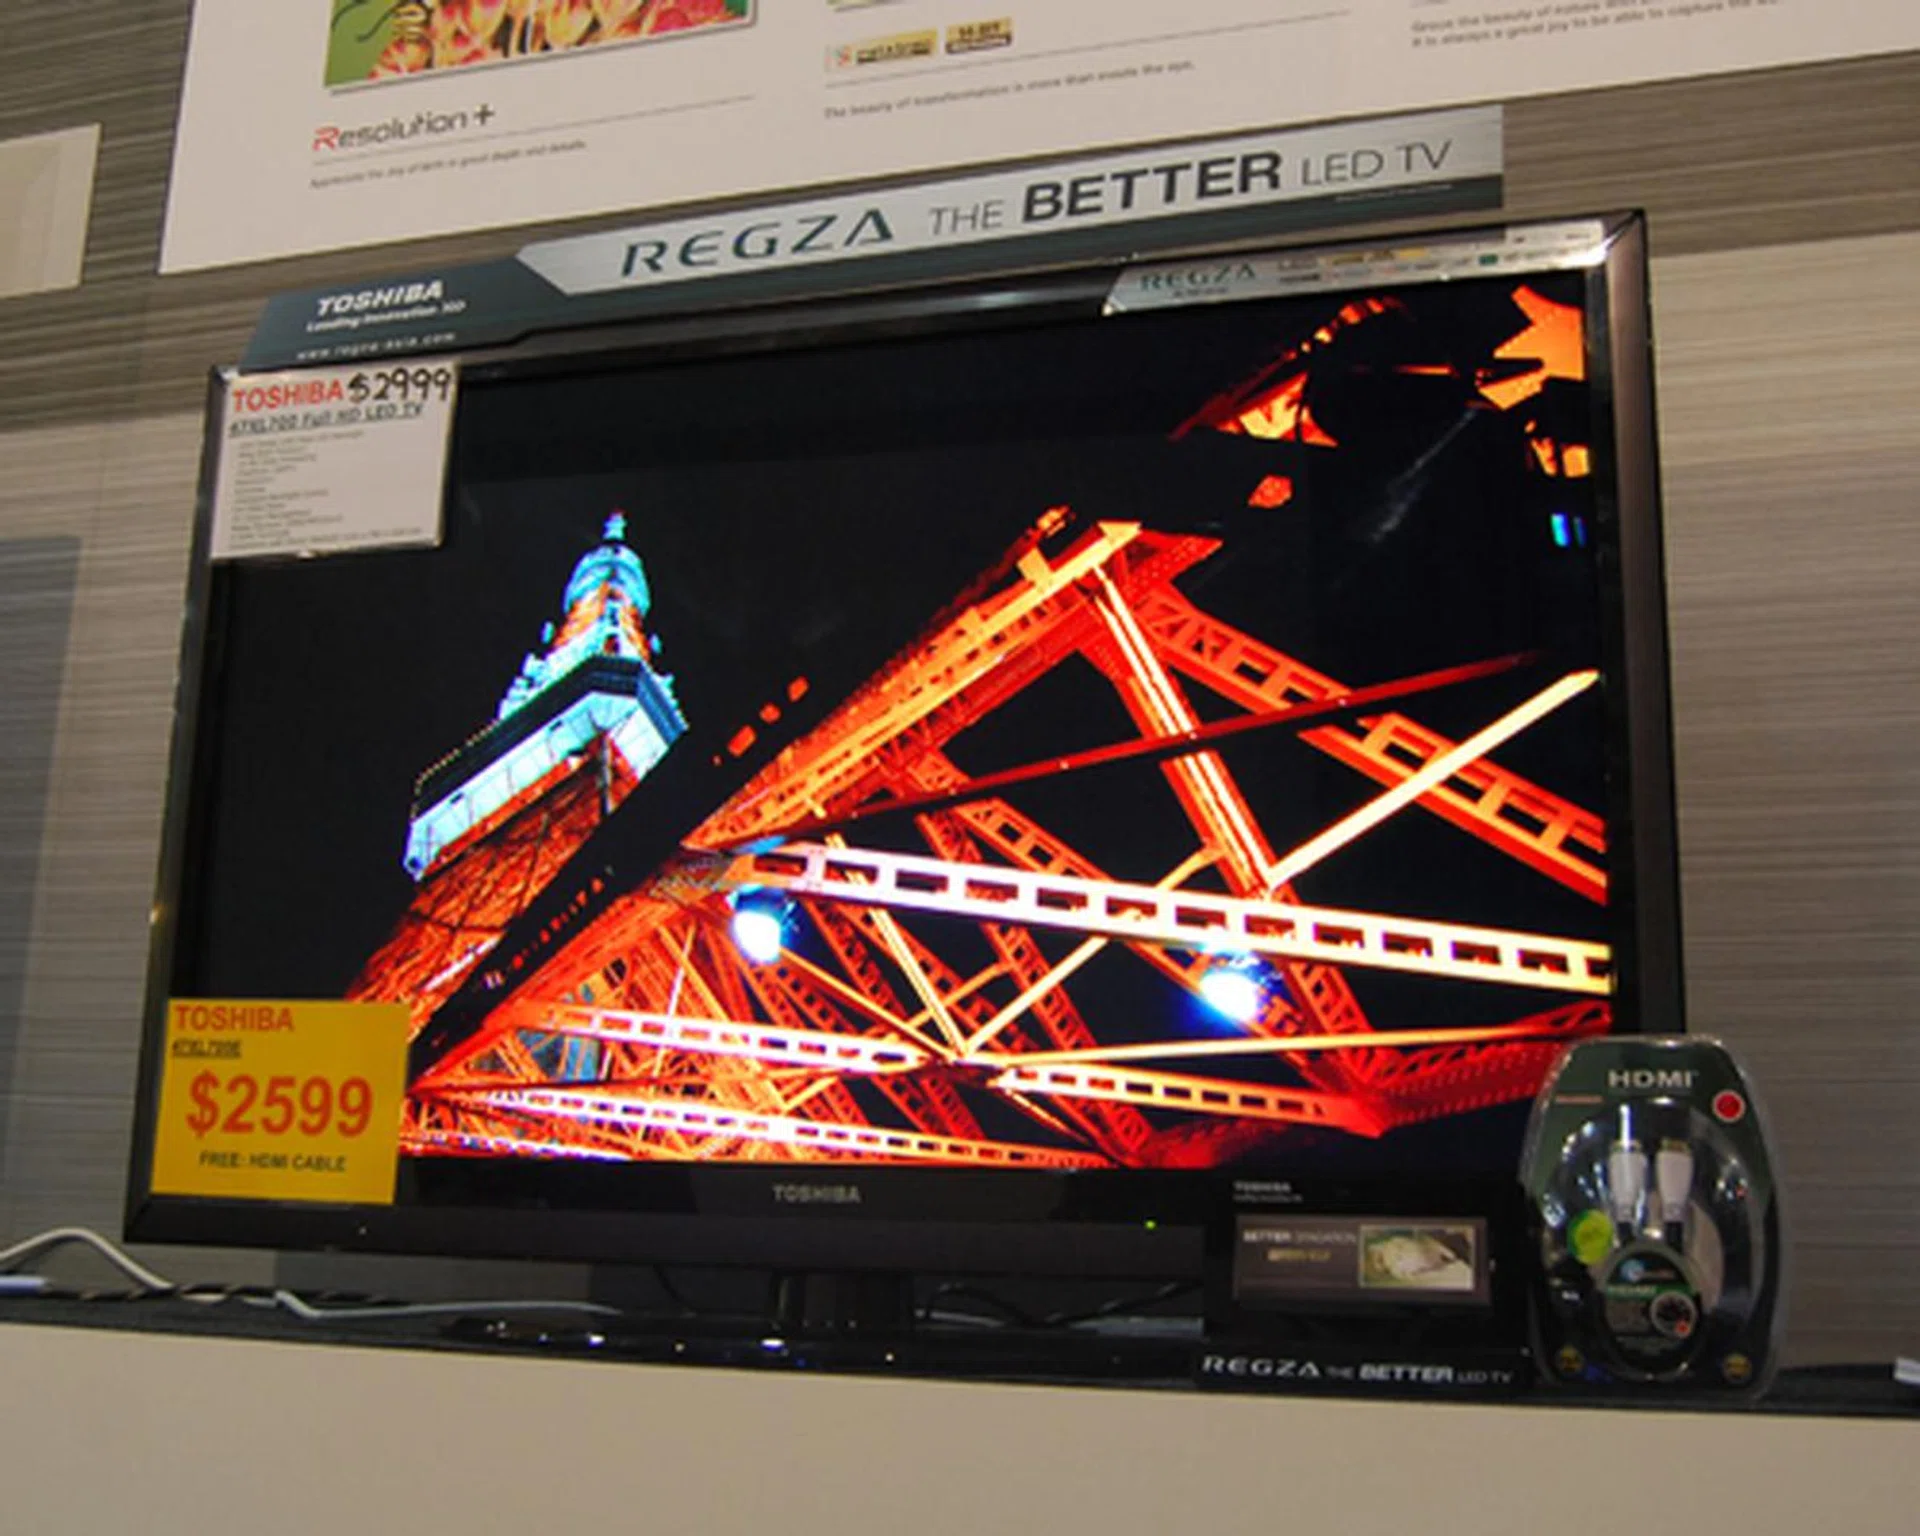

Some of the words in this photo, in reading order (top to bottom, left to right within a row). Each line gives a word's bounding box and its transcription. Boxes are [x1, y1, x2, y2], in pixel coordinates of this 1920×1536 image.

[311, 111, 469, 151] Resolution
[620, 207, 894, 278] REGZA
[928, 198, 1004, 236] THE
[1021, 150, 1283, 223] BETTER
[1302, 149, 1385, 186] LED
[1396, 138, 1453, 173] TV
[1139, 263, 1257, 291] REGZA
[317, 279, 444, 316] TOSHIBA
[232, 377, 345, 413] TOSHIBA
[347, 366, 452, 404] $2999
[174, 1005, 296, 1032] TOSHIBA
[1608, 1069, 1695, 1089] HDMI
[185, 1069, 374, 1140] $2599
[292, 1154, 347, 1173] CABLE
[771, 1184, 862, 1204] TOSHIBA
[1202, 1356, 1321, 1378] REGZA
[1359, 1363, 1454, 1384] BETTER
